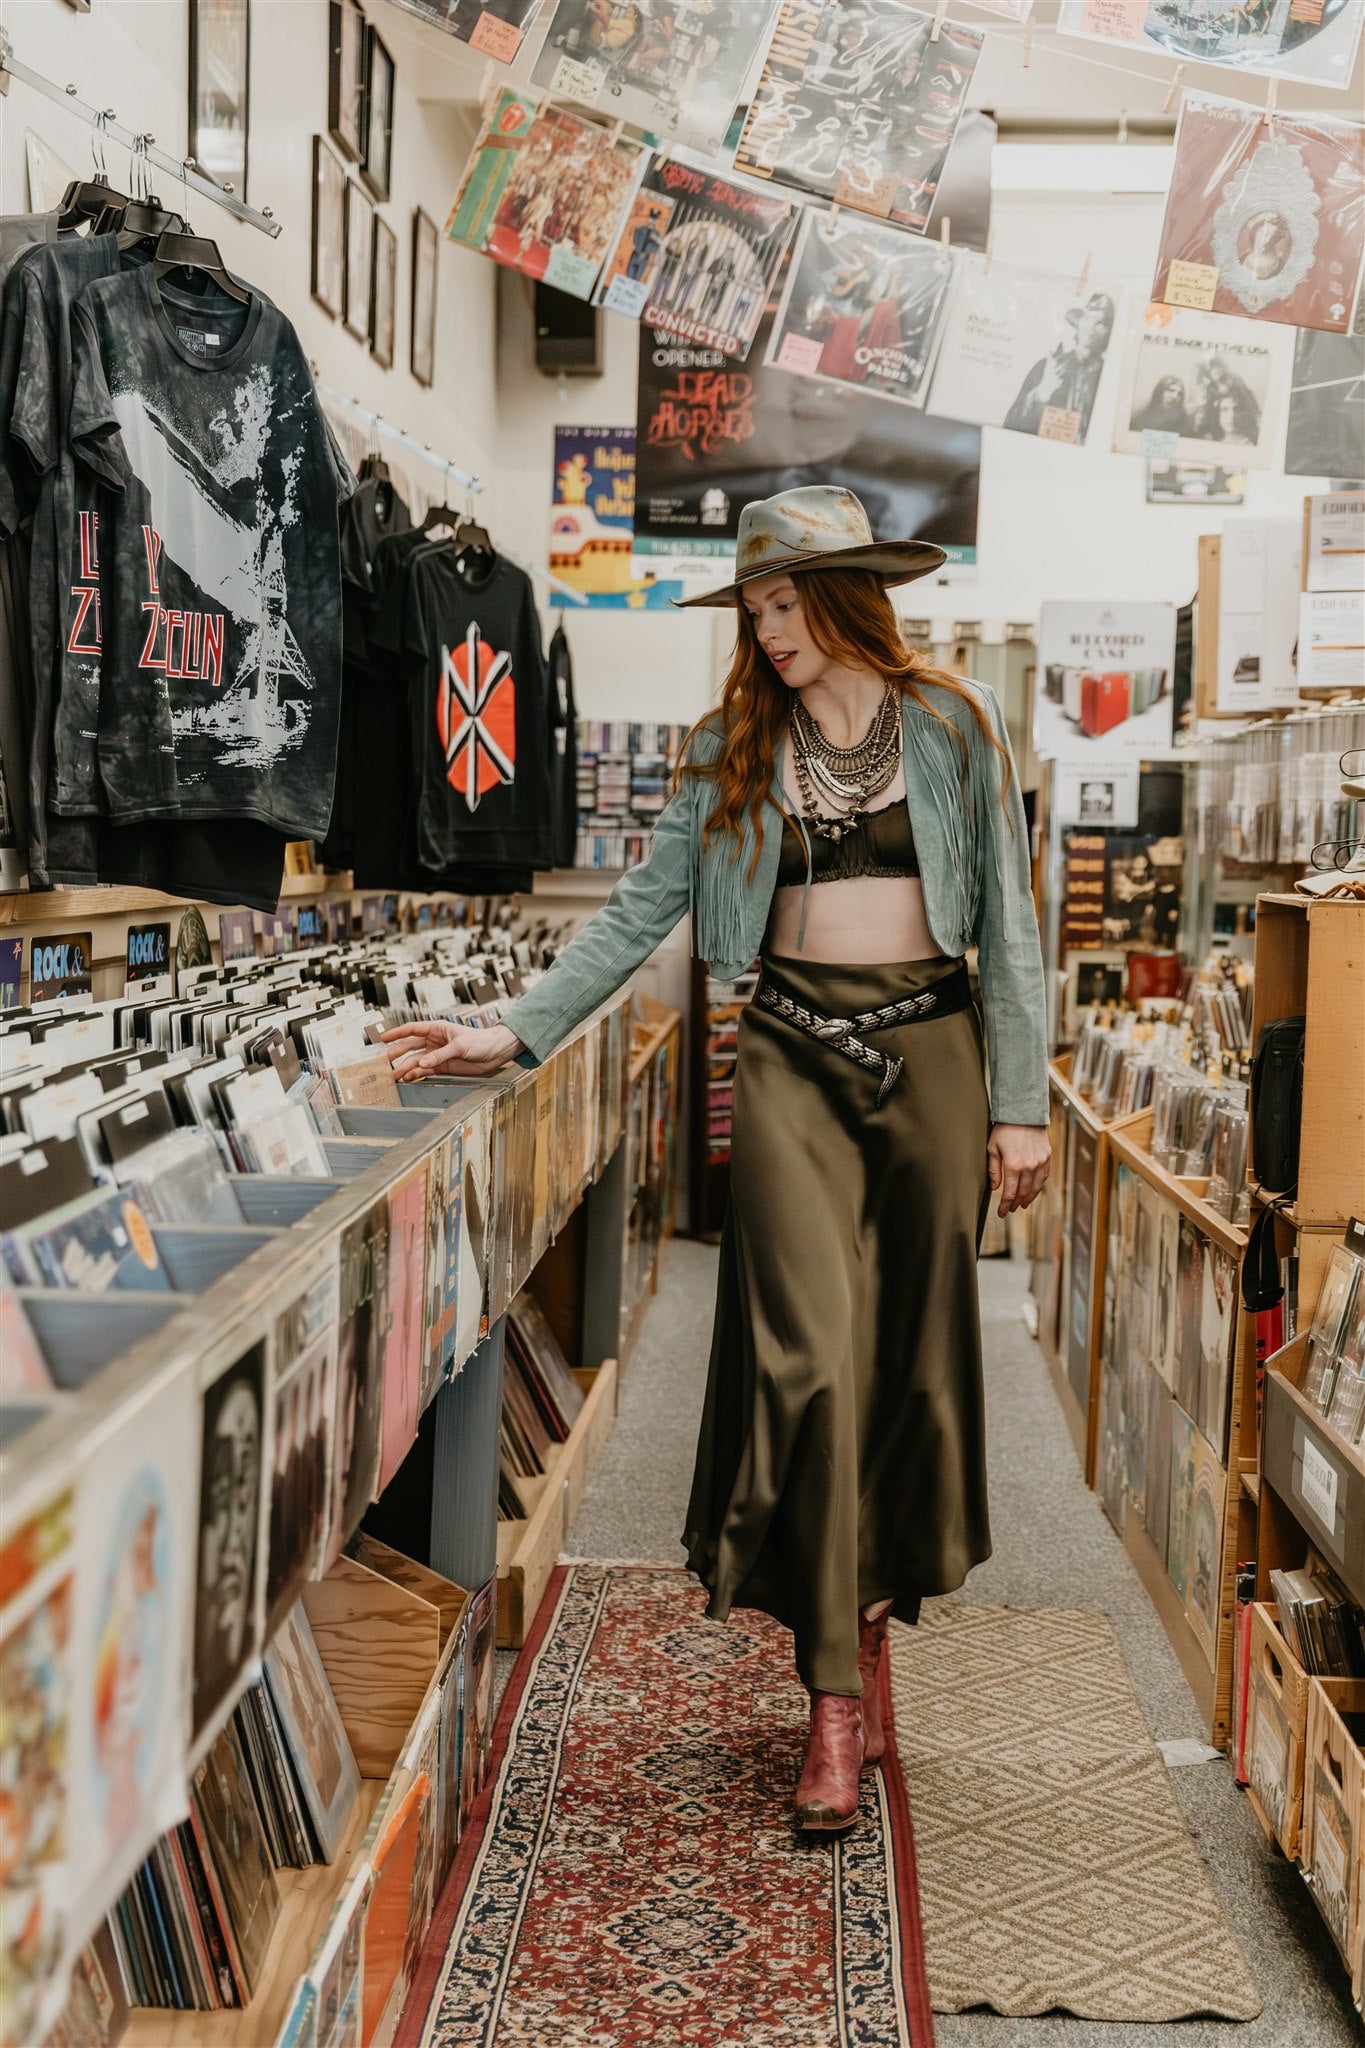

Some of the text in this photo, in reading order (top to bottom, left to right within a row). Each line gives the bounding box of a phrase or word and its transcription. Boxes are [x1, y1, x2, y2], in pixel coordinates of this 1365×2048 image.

[645, 305, 740, 353] CONVICTED
[676, 370, 754, 405] DEAD
[33, 943, 84, 983] ROCK &
[129, 932, 165, 966] ROCK &
